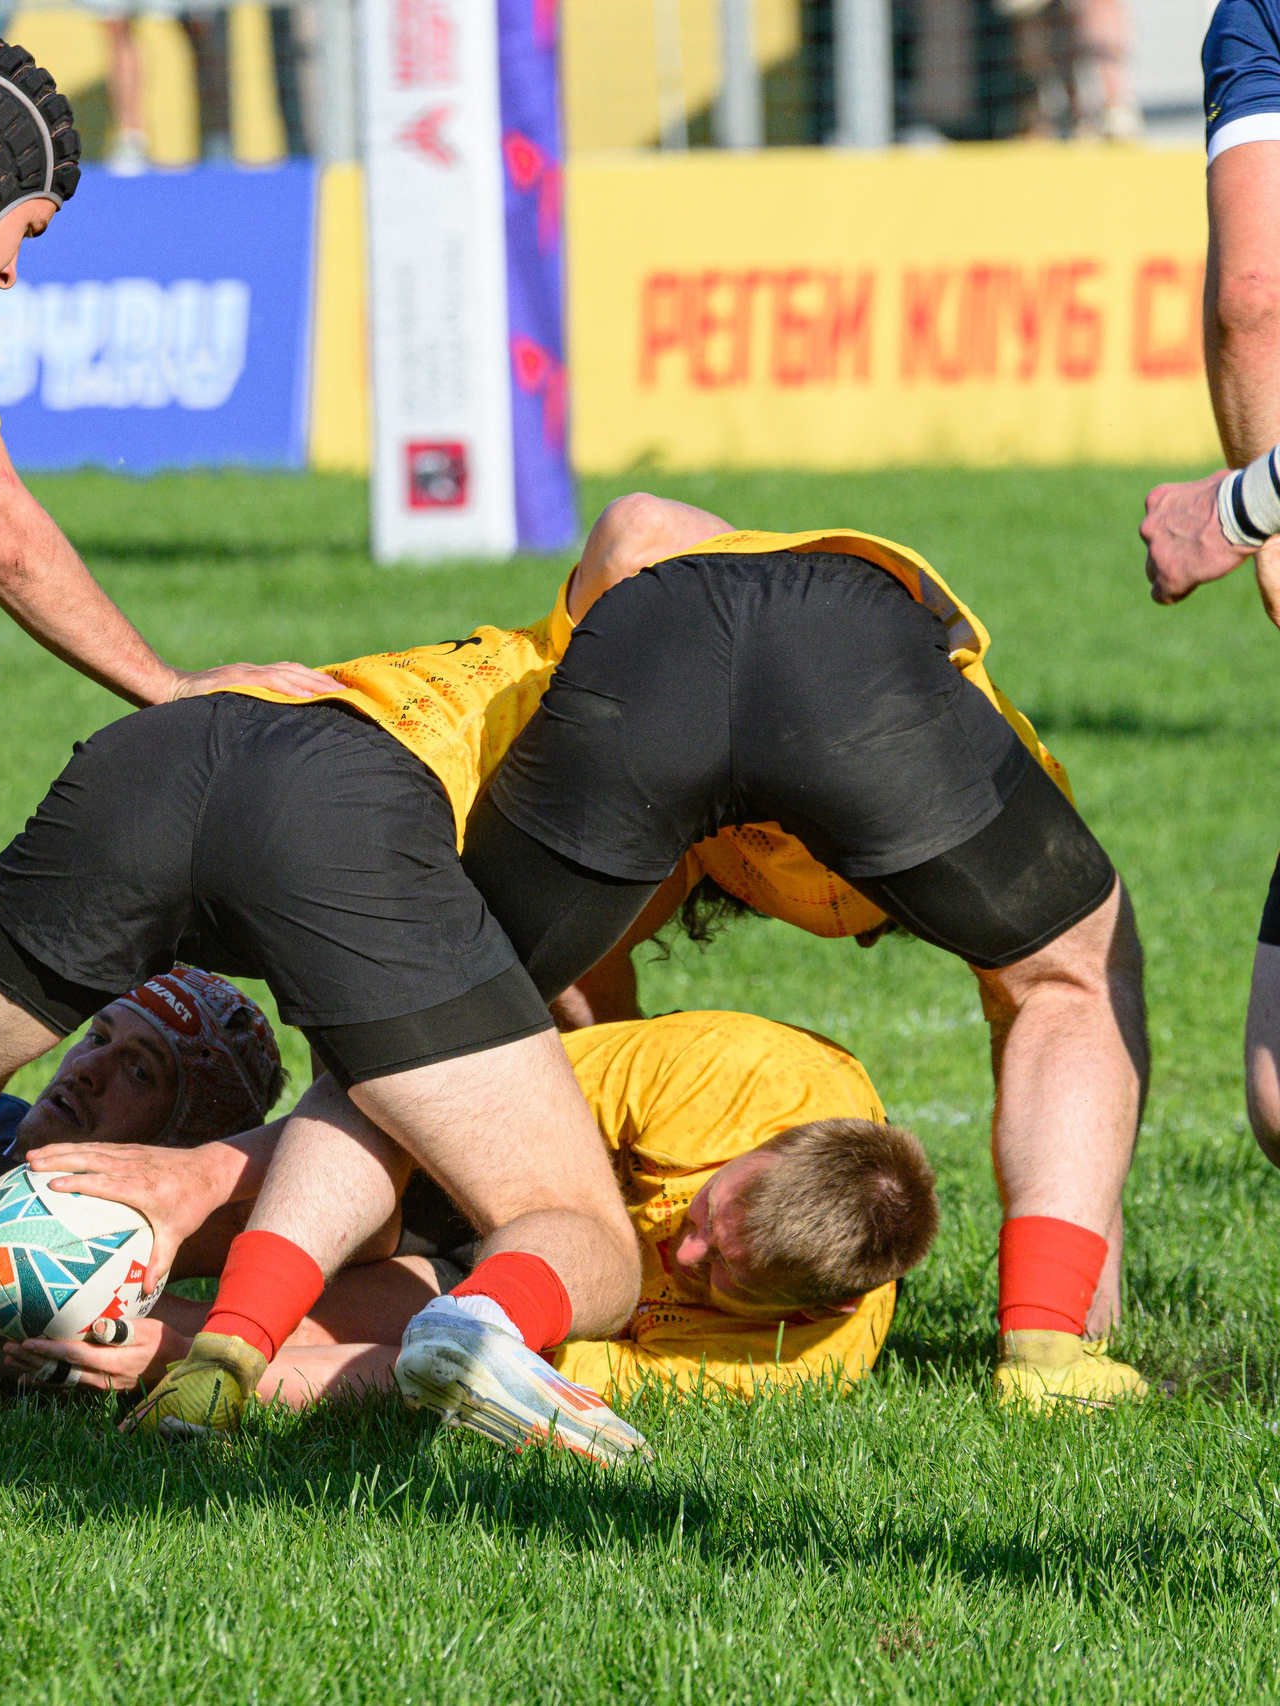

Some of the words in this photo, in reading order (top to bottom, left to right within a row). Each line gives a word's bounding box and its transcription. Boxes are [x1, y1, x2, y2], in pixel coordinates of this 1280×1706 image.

[638, 266, 875, 391] РЕГБИ
[901, 259, 1100, 385] КЛУБ
[143, 980, 192, 1022] IMPACT
